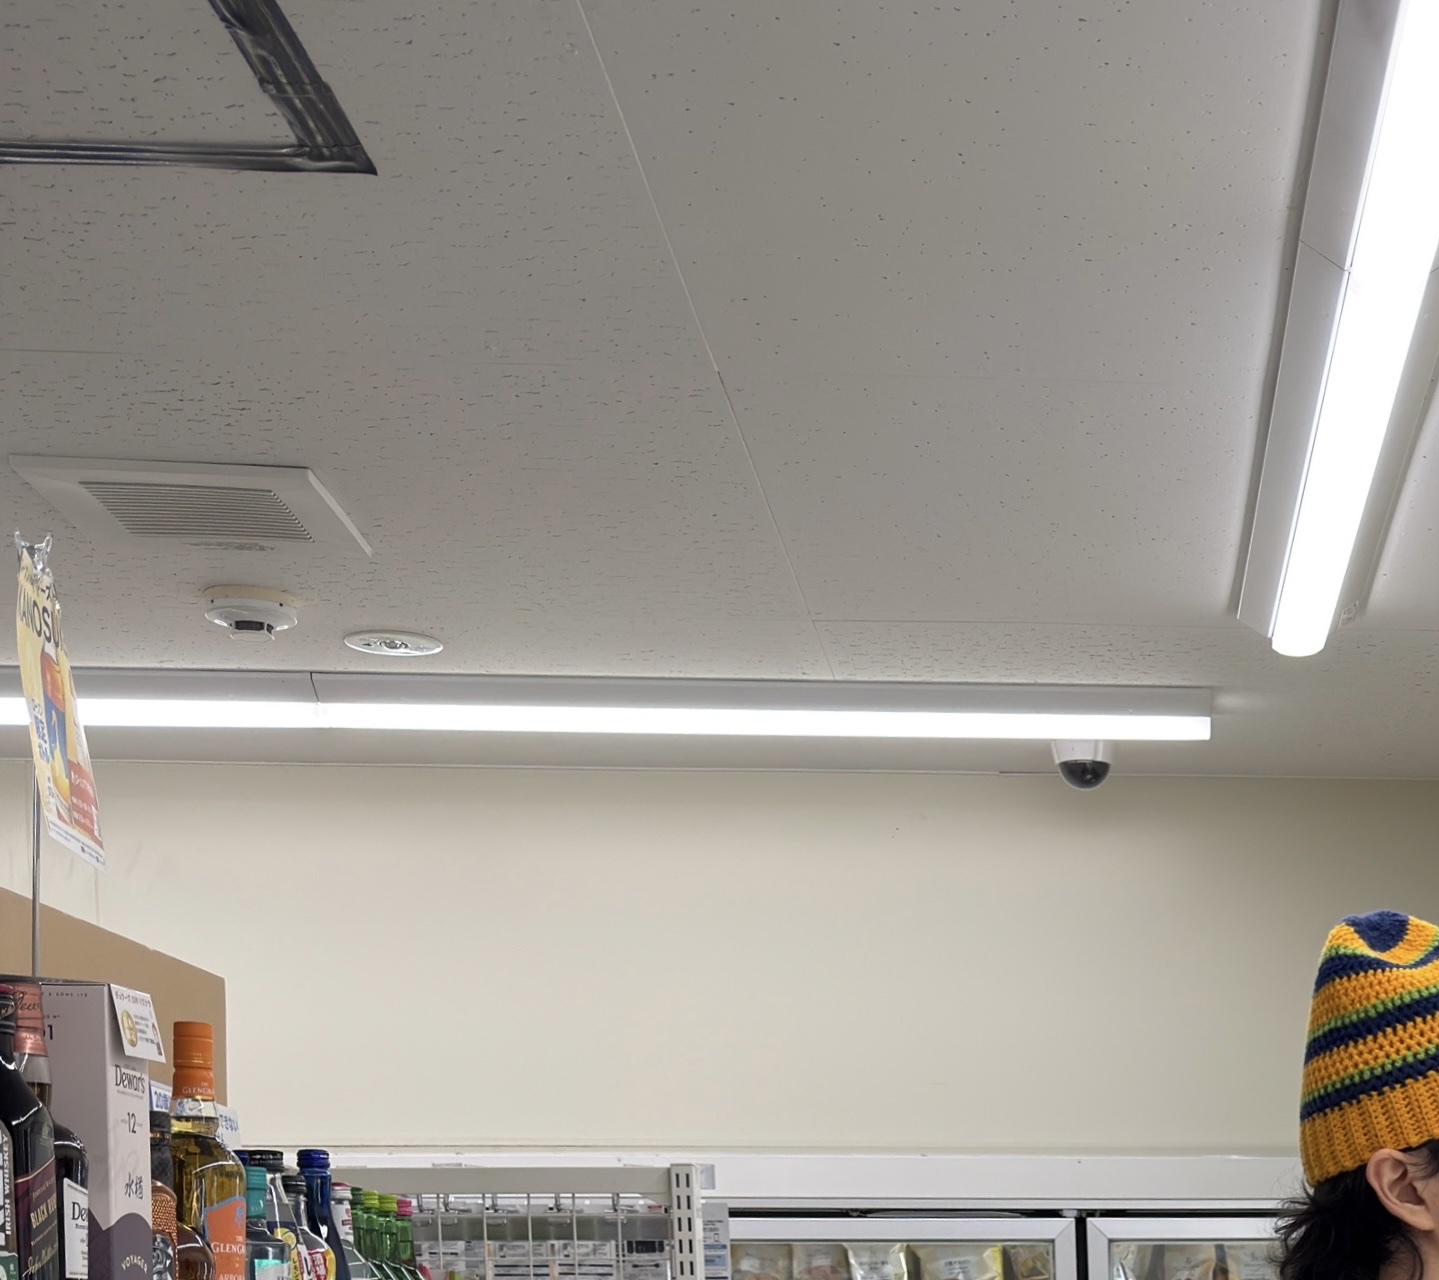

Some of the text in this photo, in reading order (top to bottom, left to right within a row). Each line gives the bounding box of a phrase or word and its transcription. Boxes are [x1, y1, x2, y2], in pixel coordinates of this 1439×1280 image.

[115, 1064, 146, 1094] Dewar's
[126, 1112, 137, 1134] 12
[121, 1254, 148, 1275] VOYAGER
